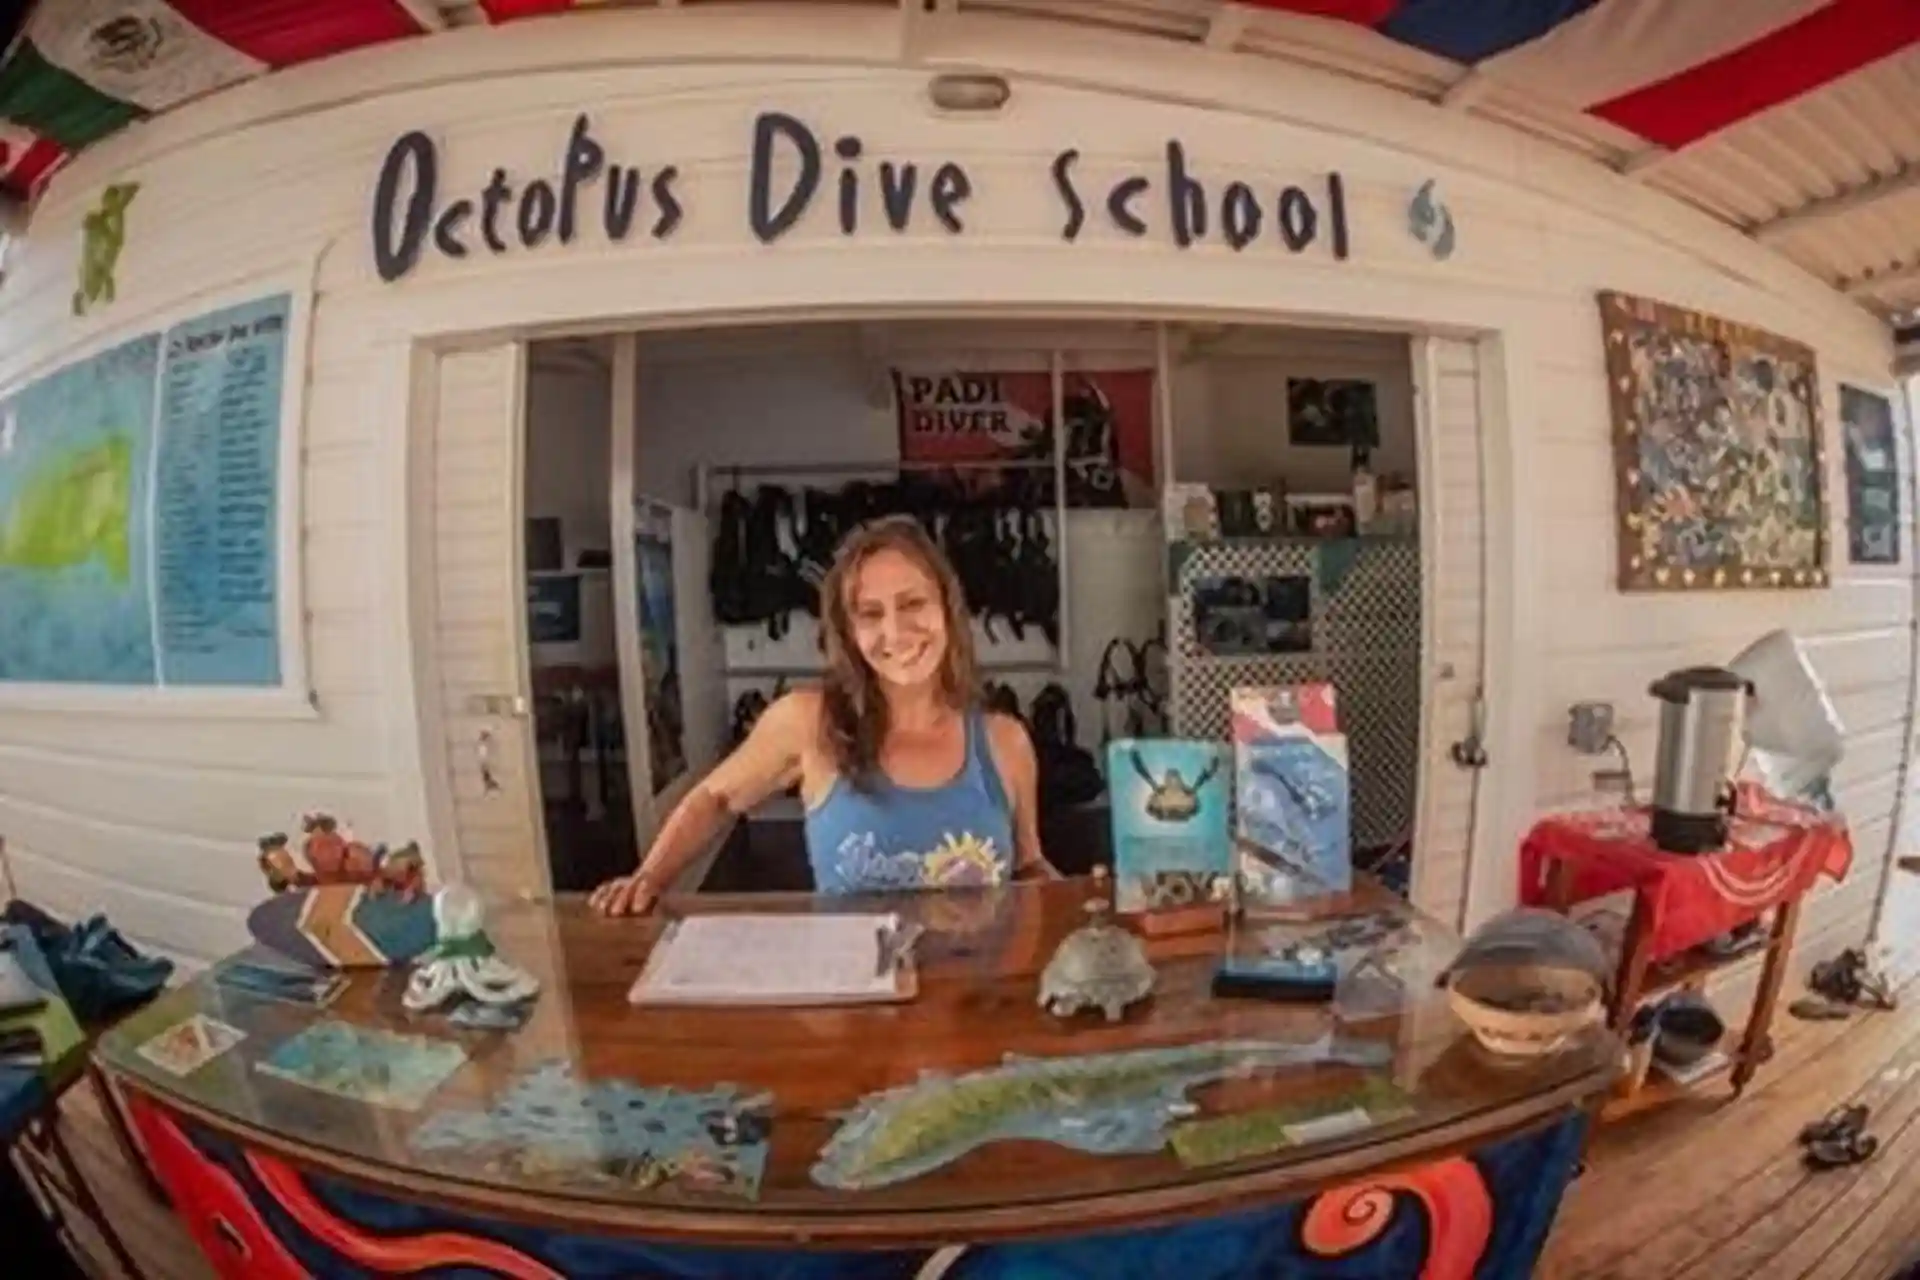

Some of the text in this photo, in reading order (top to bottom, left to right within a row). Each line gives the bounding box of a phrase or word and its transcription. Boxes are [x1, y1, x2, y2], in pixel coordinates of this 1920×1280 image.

[751, 112, 971, 244] Dive
[1052, 140, 1348, 260] School
[911, 377, 1004, 404] PADI
